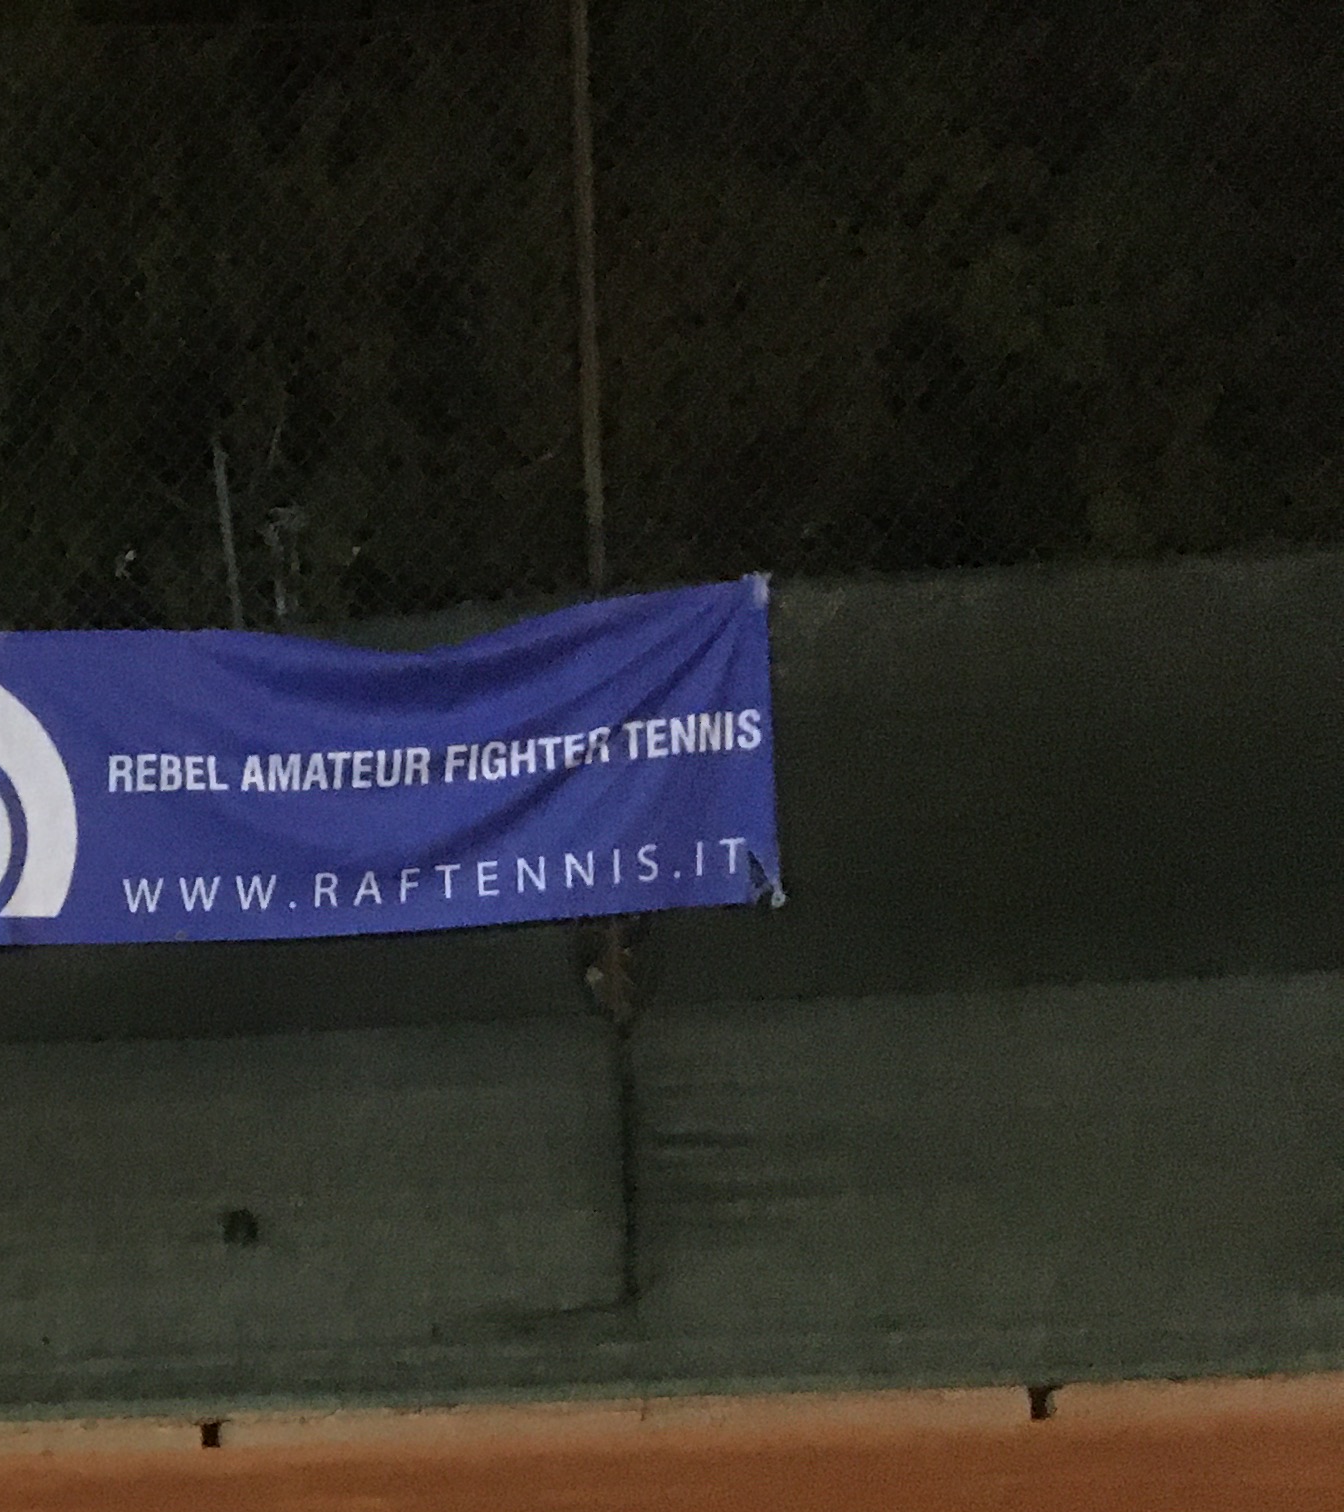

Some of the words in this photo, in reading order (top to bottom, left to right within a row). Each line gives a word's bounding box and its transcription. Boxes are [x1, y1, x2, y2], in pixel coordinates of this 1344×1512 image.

[108, 754, 229, 793] REBEL
[241, 746, 431, 794] AMATEUR
[443, 726, 611, 785] FIGHTER
[623, 707, 763, 761] TENNIS
[122, 836, 748, 914] WWW.RAFTENNIS.IT
